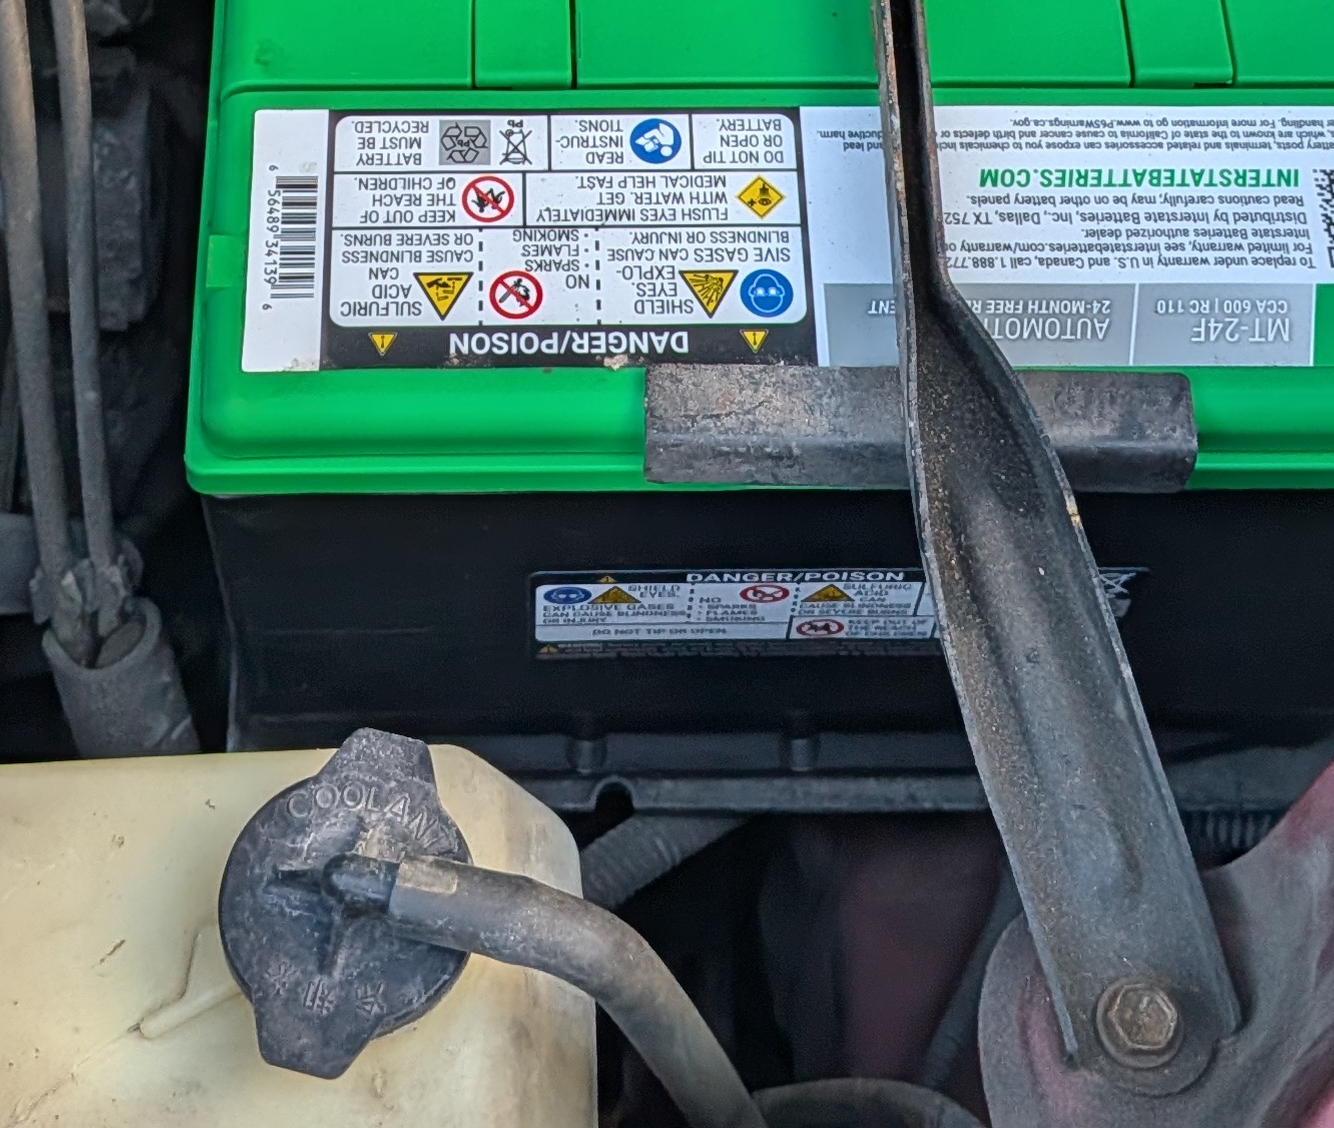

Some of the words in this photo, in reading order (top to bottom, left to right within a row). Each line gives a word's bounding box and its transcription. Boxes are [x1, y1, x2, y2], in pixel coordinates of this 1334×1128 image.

[351, 120, 430, 133] RECYCLED.
[507, 119, 524, 128] Pb
[574, 119, 623, 132] TIONS.
[716, 118, 782, 132] BATTERY.
[1010, 117, 1140, 128] www.P65Warnings.ca.gov.
[1143, 119, 1153, 127] to
[1156, 117, 1168, 127] go
[1175, 119, 1228, 128] information
[1231, 119, 1257, 127] more
[1259, 119, 1275, 128] For
[1277, 117, 1324, 128] handling.
[719, 134, 760, 147] OPEN
[763, 134, 783, 147] OR
[817, 130, 845, 140] harm.
[848, 130, 882, 140] ductive
[941, 130, 951, 138] or
[953, 130, 990, 140] defects
[992, 130, 1016, 140] birth
[1018, 130, 1037, 140] and
[1039, 130, 1073, 138] cancer
[1076, 130, 1105, 138] cause
[1108, 130, 1117, 139] to
[1120, 130, 1168, 140] California
[1170, 130, 1181, 140] of
[1184, 130, 1209, 140] state
[1212, 130, 1228, 140] the
[1231, 130, 1240, 139] to
[1244, 130, 1275, 140] known
[1278, 130, 1293, 138] are
[1297, 130, 1325, 140] which
[357, 136, 376, 149] BE
[380, 136, 422, 149] MUST
[457, 139, 470, 147] Pb
[555, 135, 624, 148] INSTRUC-
[843, 142, 864, 152] lead
[959, 142, 1010, 151] chemicals
[1013, 142, 1022, 150] to
[1025, 139, 1043, 149] you
[1045, 139, 1081, 149] expose
[1104, 142, 1164, 151] accessories
[1167, 142, 1200, 151] related
[1204, 142, 1222, 151] and
[1225, 142, 1272, 151] terminals
[1273, 139, 1303, 150] posts,
[356, 153, 422, 166] BATTERY
[585, 151, 624, 165] READ
[703, 150, 726, 164] TIP
[728, 150, 760, 164] NOT
[763, 150, 784, 164] DO
[354, 177, 433, 190] CHILDREN.
[436, 177, 456, 190] OF
[575, 175, 614, 189] FAST.
[618, 175, 656, 189] HELP
[660, 175, 726, 189] MEDICAL
[979, 168, 1300, 188] INTERSTATEBATTERIES.COM
[372, 193, 422, 207] REACH
[426, 193, 456, 207] THE
[596, 191, 625, 205] GET
[630, 191, 685, 205] WATER.
[688, 191, 727, 205] WITH
[967, 193, 1010, 207] panels.
[1014, 193, 1056, 207] battery
[1060, 195, 1091, 207] other
[1094, 195, 1109, 205] on
[1113, 195, 1127, 207] be
[1131, 193, 1156, 205] may
[1159, 193, 1214, 207] carefully;
[1218, 195, 1270, 207] cautions
[1273, 195, 1304, 207] Read
[267, 190, 281, 232] 56489
[359, 210, 379, 223] OF
[383, 210, 414, 223] OUT
[417, 210, 456, 223] KEEP
[536, 208, 636, 222] IMMEDIATELY
[640, 208, 677, 222] EYES
[681, 208, 728, 222] FLUSH
[994, 210, 1040, 225] Dallas,
[1044, 210, 1073, 225] Inc.,
[1076, 210, 1141, 225] Batteries,
[1213, 209, 1229, 225] by
[943, 212, 968, 225] 752
[973, 212, 992, 225] TX
[1144, 212, 1209, 225] Interstate
[1233, 212, 1307, 225] Distributed
[339, 233, 392, 246] BURNS.
[395, 233, 450, 246] SEVERE
[453, 233, 474, 246] OR
[512, 229, 580, 242] SMOKING
[629, 230, 682, 244] INJURY.
[685, 230, 706, 244] OR
[710, 230, 789, 244] BLINDNESS
[1081, 228, 1122, 240] dealer.
[1125, 228, 1190, 240] authorized
[1193, 228, 1248, 240] Batteries
[1251, 228, 1310, 240] Interstate
[521, 244, 580, 257] FLAMES
[960, 240, 1160, 254] interstatebatteries.com/warranty
[1164, 242, 1185, 252] see
[1188, 240, 1244, 252] warranty,
[1247, 242, 1289, 254] limited
[1293, 242, 1312, 254] For
[341, 250, 423, 263] BLINDNESS
[426, 250, 474, 263] CAUSE
[607, 247, 655, 262] CAUSE
[659, 247, 689, 262] CAN
[694, 247, 748, 262] GASES
[754, 247, 790, 262] SIVE
[1157, 254, 1210, 266] warranty
[262, 239, 278, 285] 34139
[524, 259, 580, 271] SPARKS
[946, 256, 1007, 269] 1.888.772
[1010, 256, 1031, 269] call
[1034, 256, 1084, 269] Canada,
[1087, 256, 1110, 269] and
[1114, 256, 1139, 269] U.S.
[1142, 256, 1154, 269] in
[1213, 256, 1248, 269] under
[1251, 254, 1296, 269] replace
[1300, 256, 1316, 269] To
[368, 267, 400, 280] CAN
[615, 265, 675, 280] EXPLO-
[565, 274, 590, 289] NO
[372, 284, 412, 298] ACID
[631, 282, 678, 297] EYES.
[340, 301, 423, 317] SULFURIC
[634, 299, 694, 314] SHIELD
[986, 300, 1024, 314] FREE
[1027, 299, 1111, 314] 24-MONTH
[1156, 299, 1185, 314] 110
[1189, 300, 1210, 313] RC
[1224, 300, 1251, 313] 600
[1256, 300, 1288, 313] CCA
[982, 317, 1110, 340] AUTOMOT
[1190, 317, 1290, 342] MT-24F
[449, 331, 689, 354] DANGER/POISON
[686, 572, 905, 582] DANGER/POISON
[285, 782, 455, 851] COOLANT
